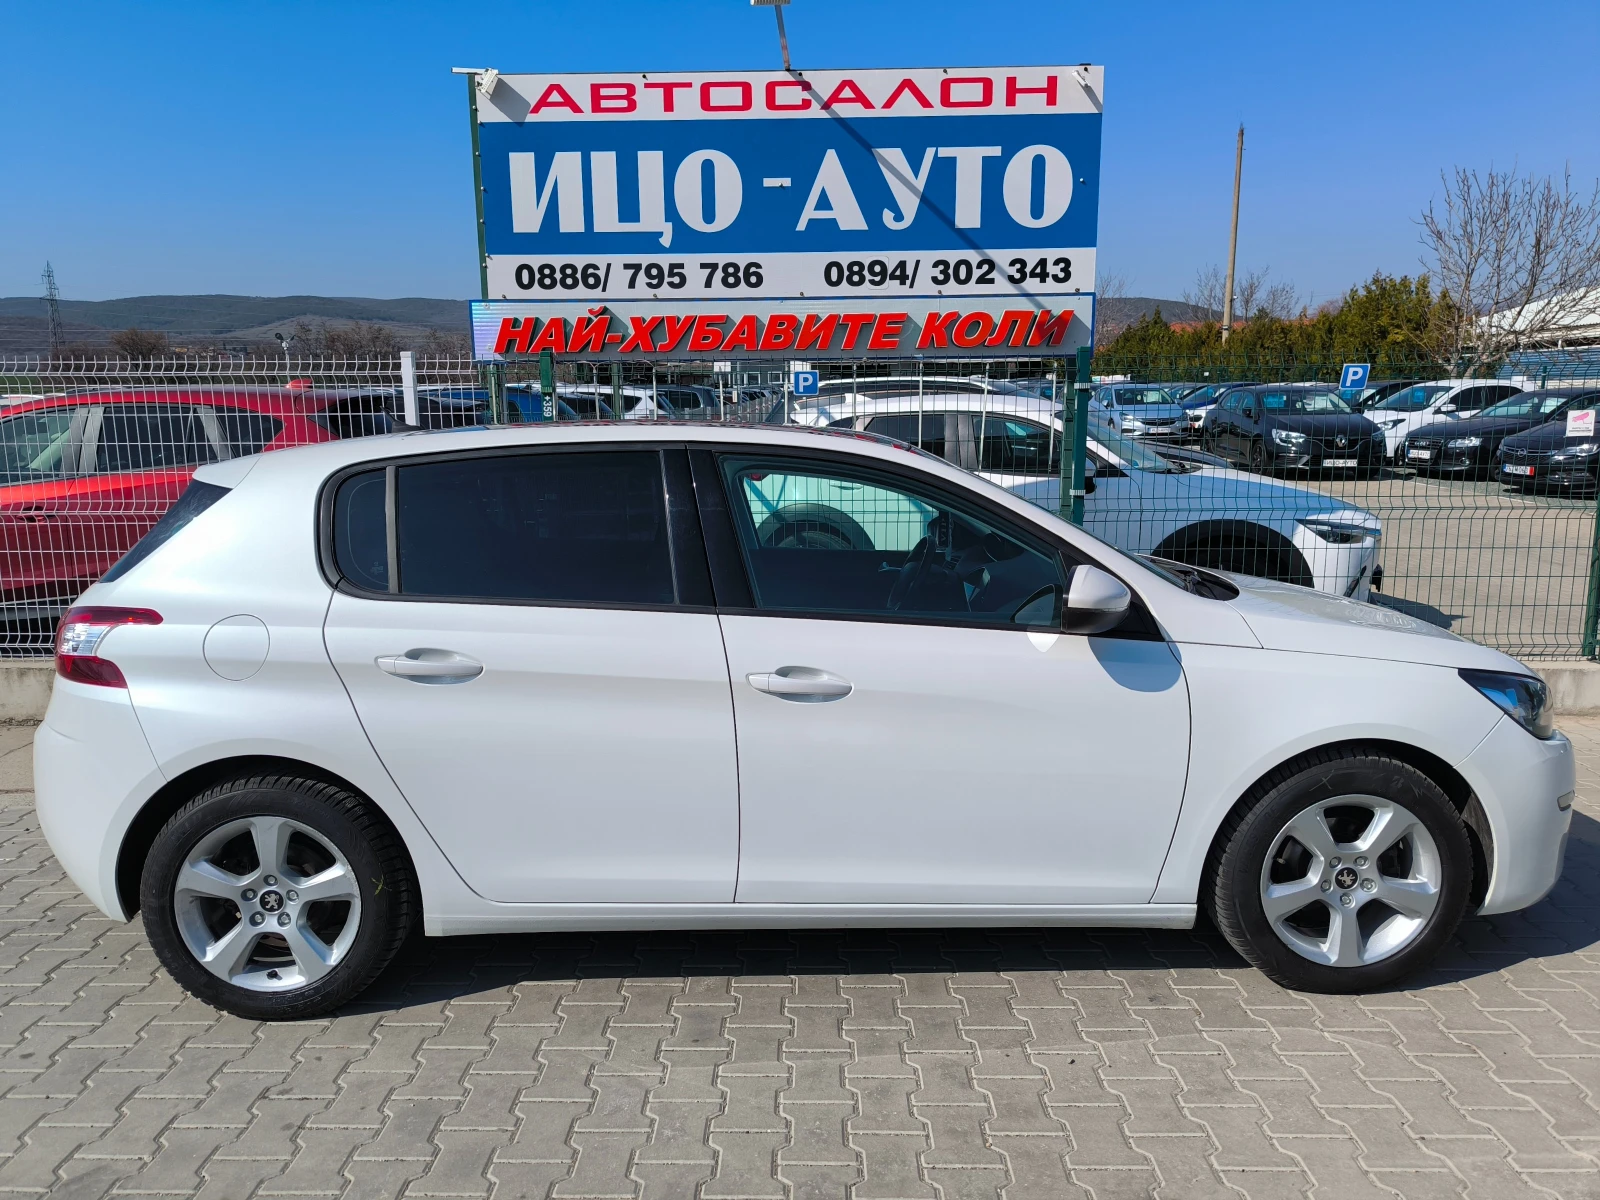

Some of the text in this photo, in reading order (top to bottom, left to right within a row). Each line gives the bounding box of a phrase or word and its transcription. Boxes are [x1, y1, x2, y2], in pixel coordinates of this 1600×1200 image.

[529, 75, 1059, 115] АВТОСАЛОН
[514, 261, 764, 293] 0886/ 795 786
[823, 257, 1072, 289] 0894/ 302 343
[493, 305, 1075, 354] НАЙ-ХУБАВИТЕ КОЛИ
[798, 373, 814, 393] P
[1345, 367, 1364, 387] P
[543, 395, 552, 417] +359
